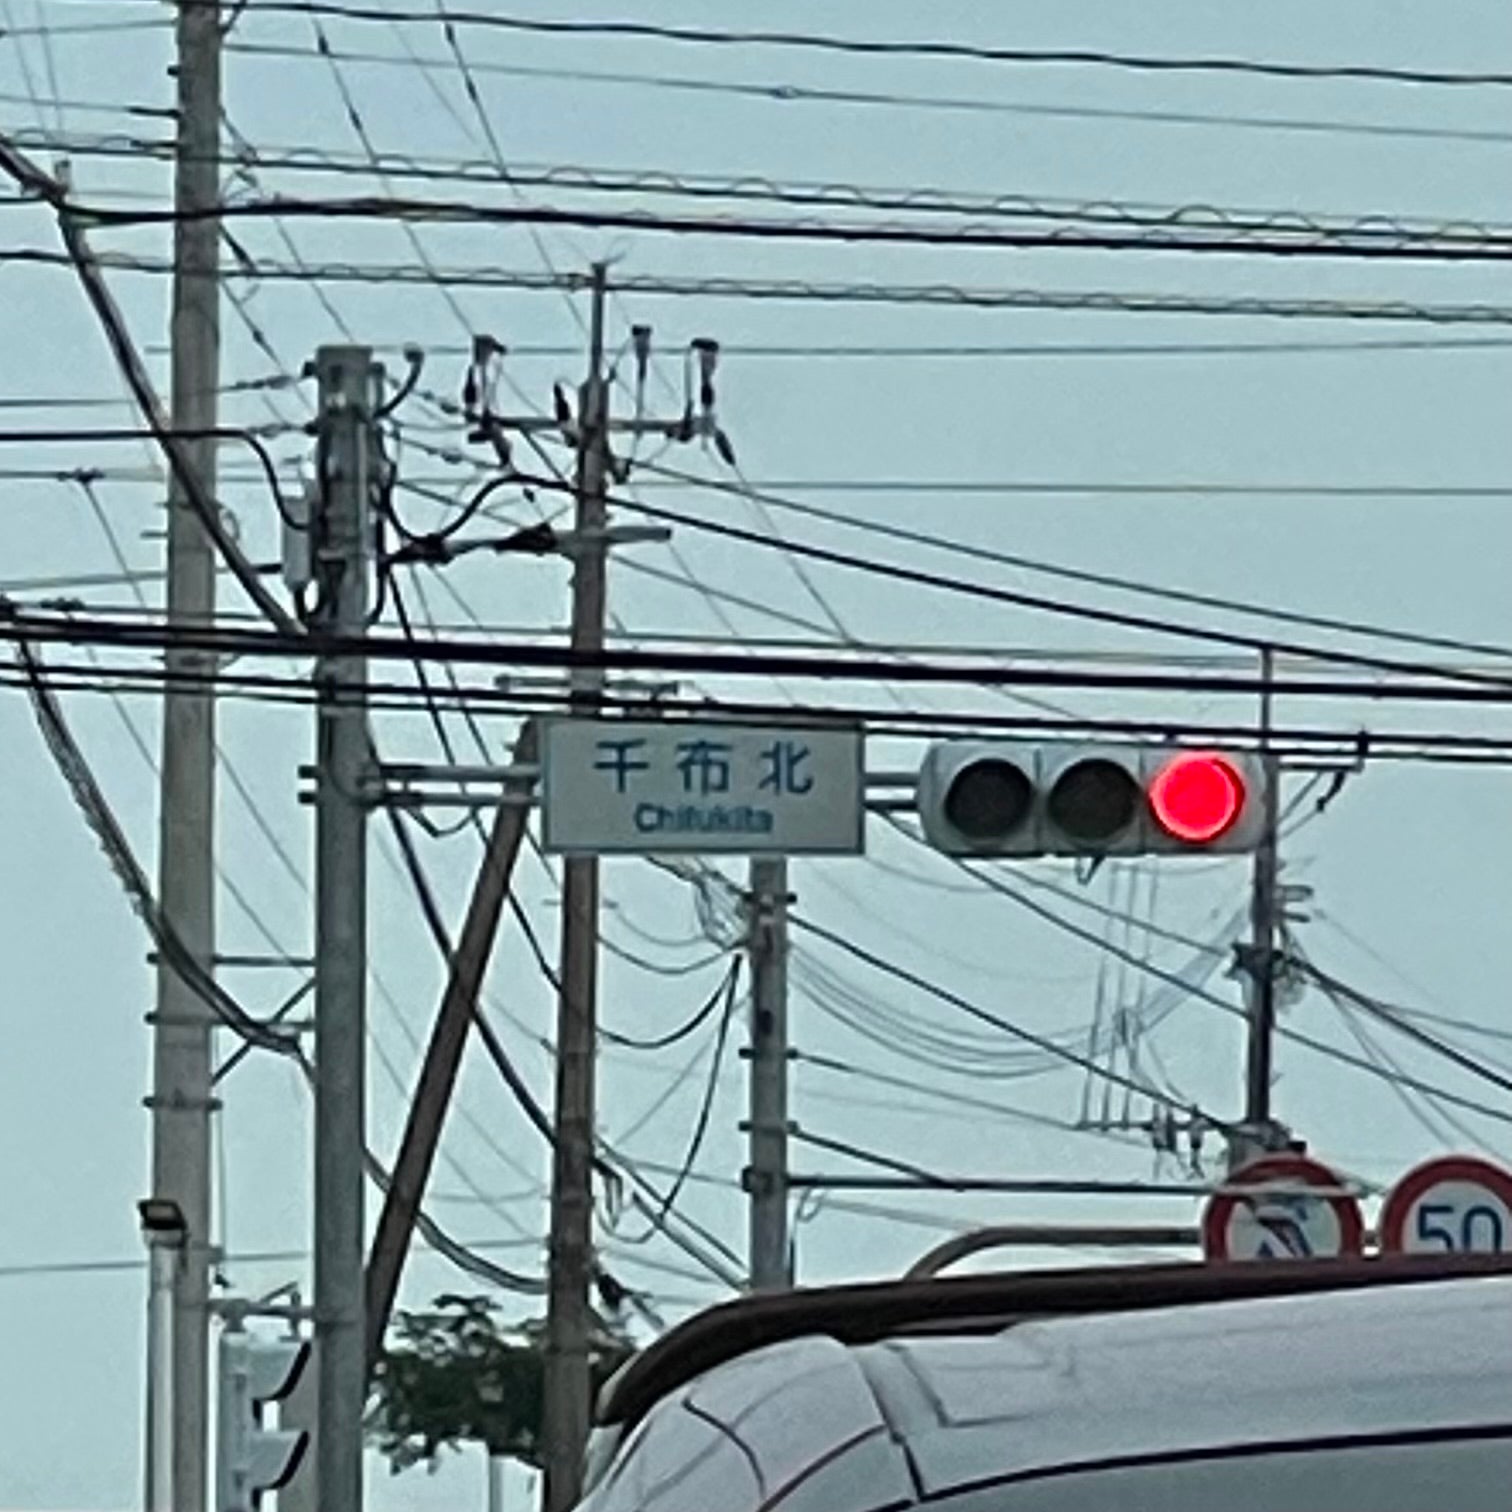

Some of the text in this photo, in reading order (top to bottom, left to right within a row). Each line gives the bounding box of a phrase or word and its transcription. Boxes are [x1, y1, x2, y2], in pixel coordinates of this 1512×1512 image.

[592, 740, 816, 796] 千布北
[1418, 1205, 1502, 1254] 50
